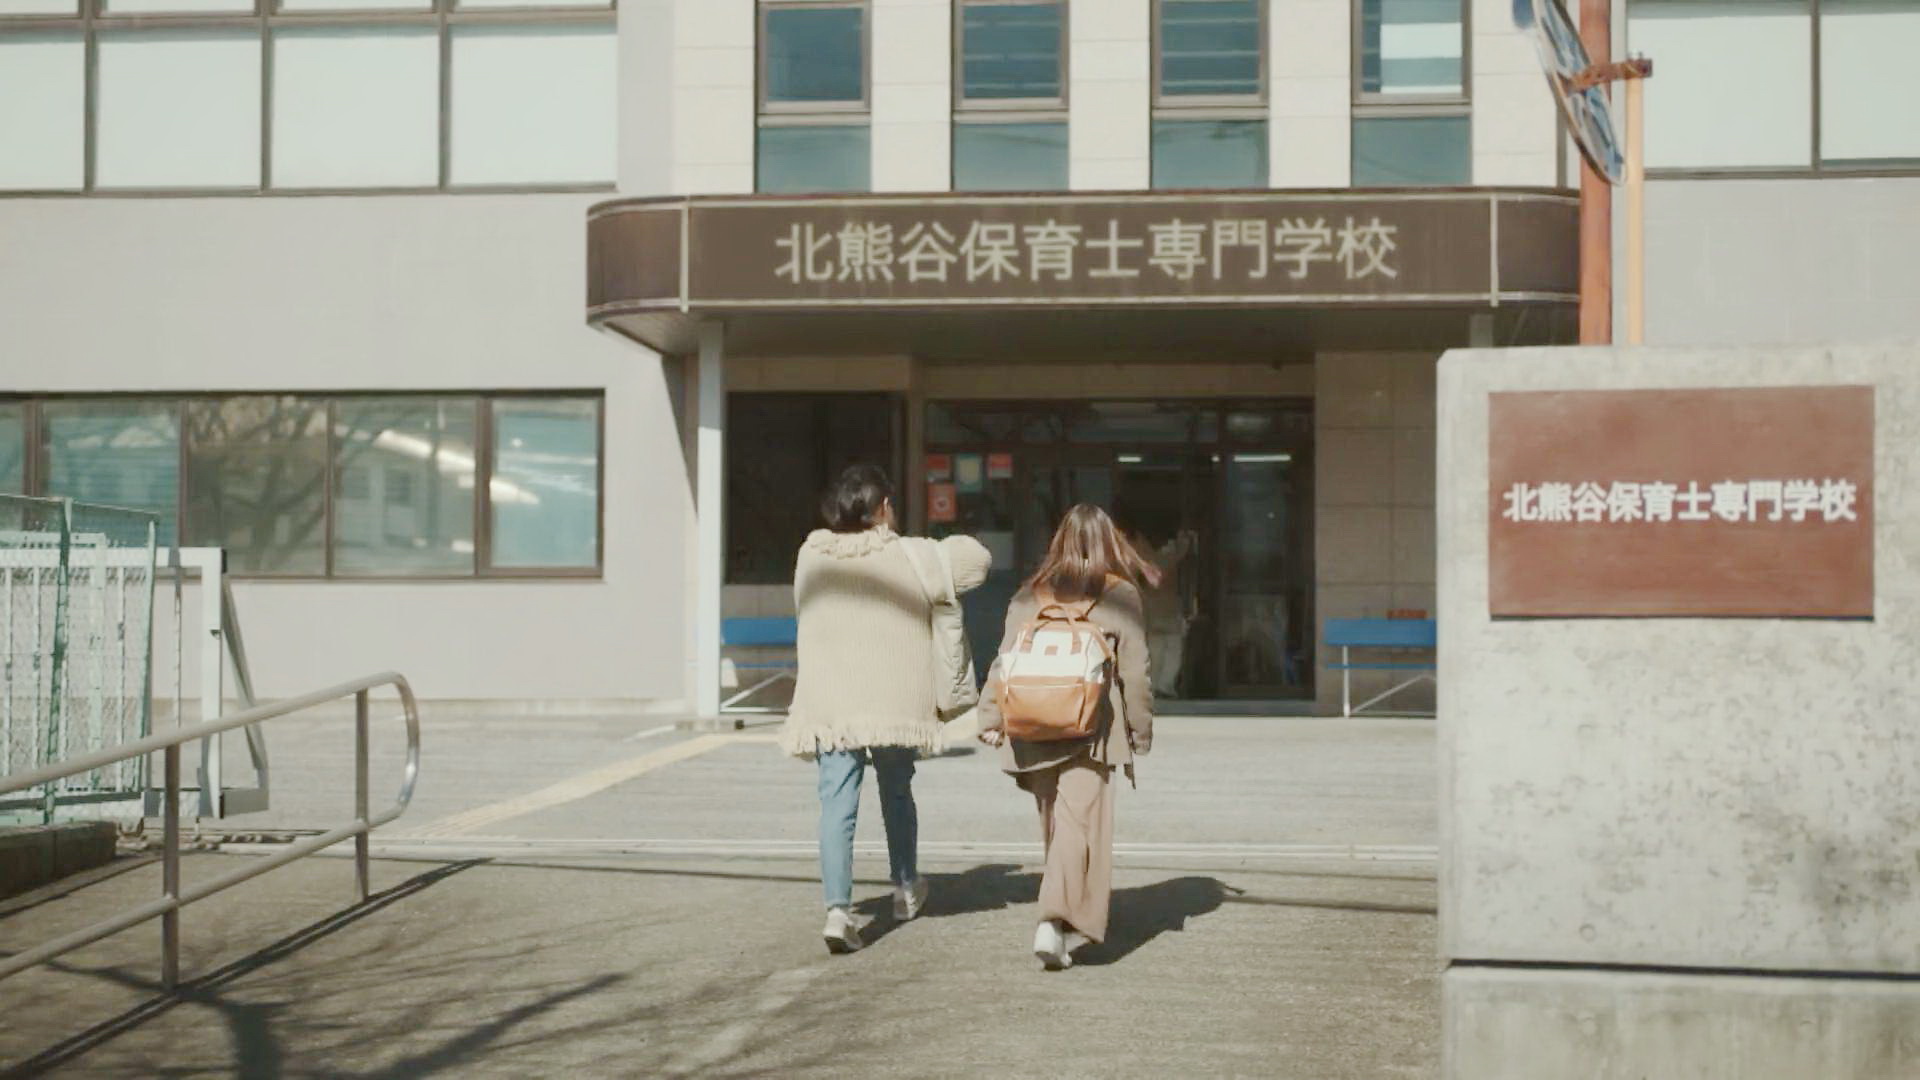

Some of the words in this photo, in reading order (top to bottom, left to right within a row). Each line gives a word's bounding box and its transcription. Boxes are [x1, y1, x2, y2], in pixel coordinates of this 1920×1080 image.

[775, 217, 1398, 283] 北熊谷保育士専門学校
[1503, 479, 1857, 522] 北熊谷保育士専門学校
